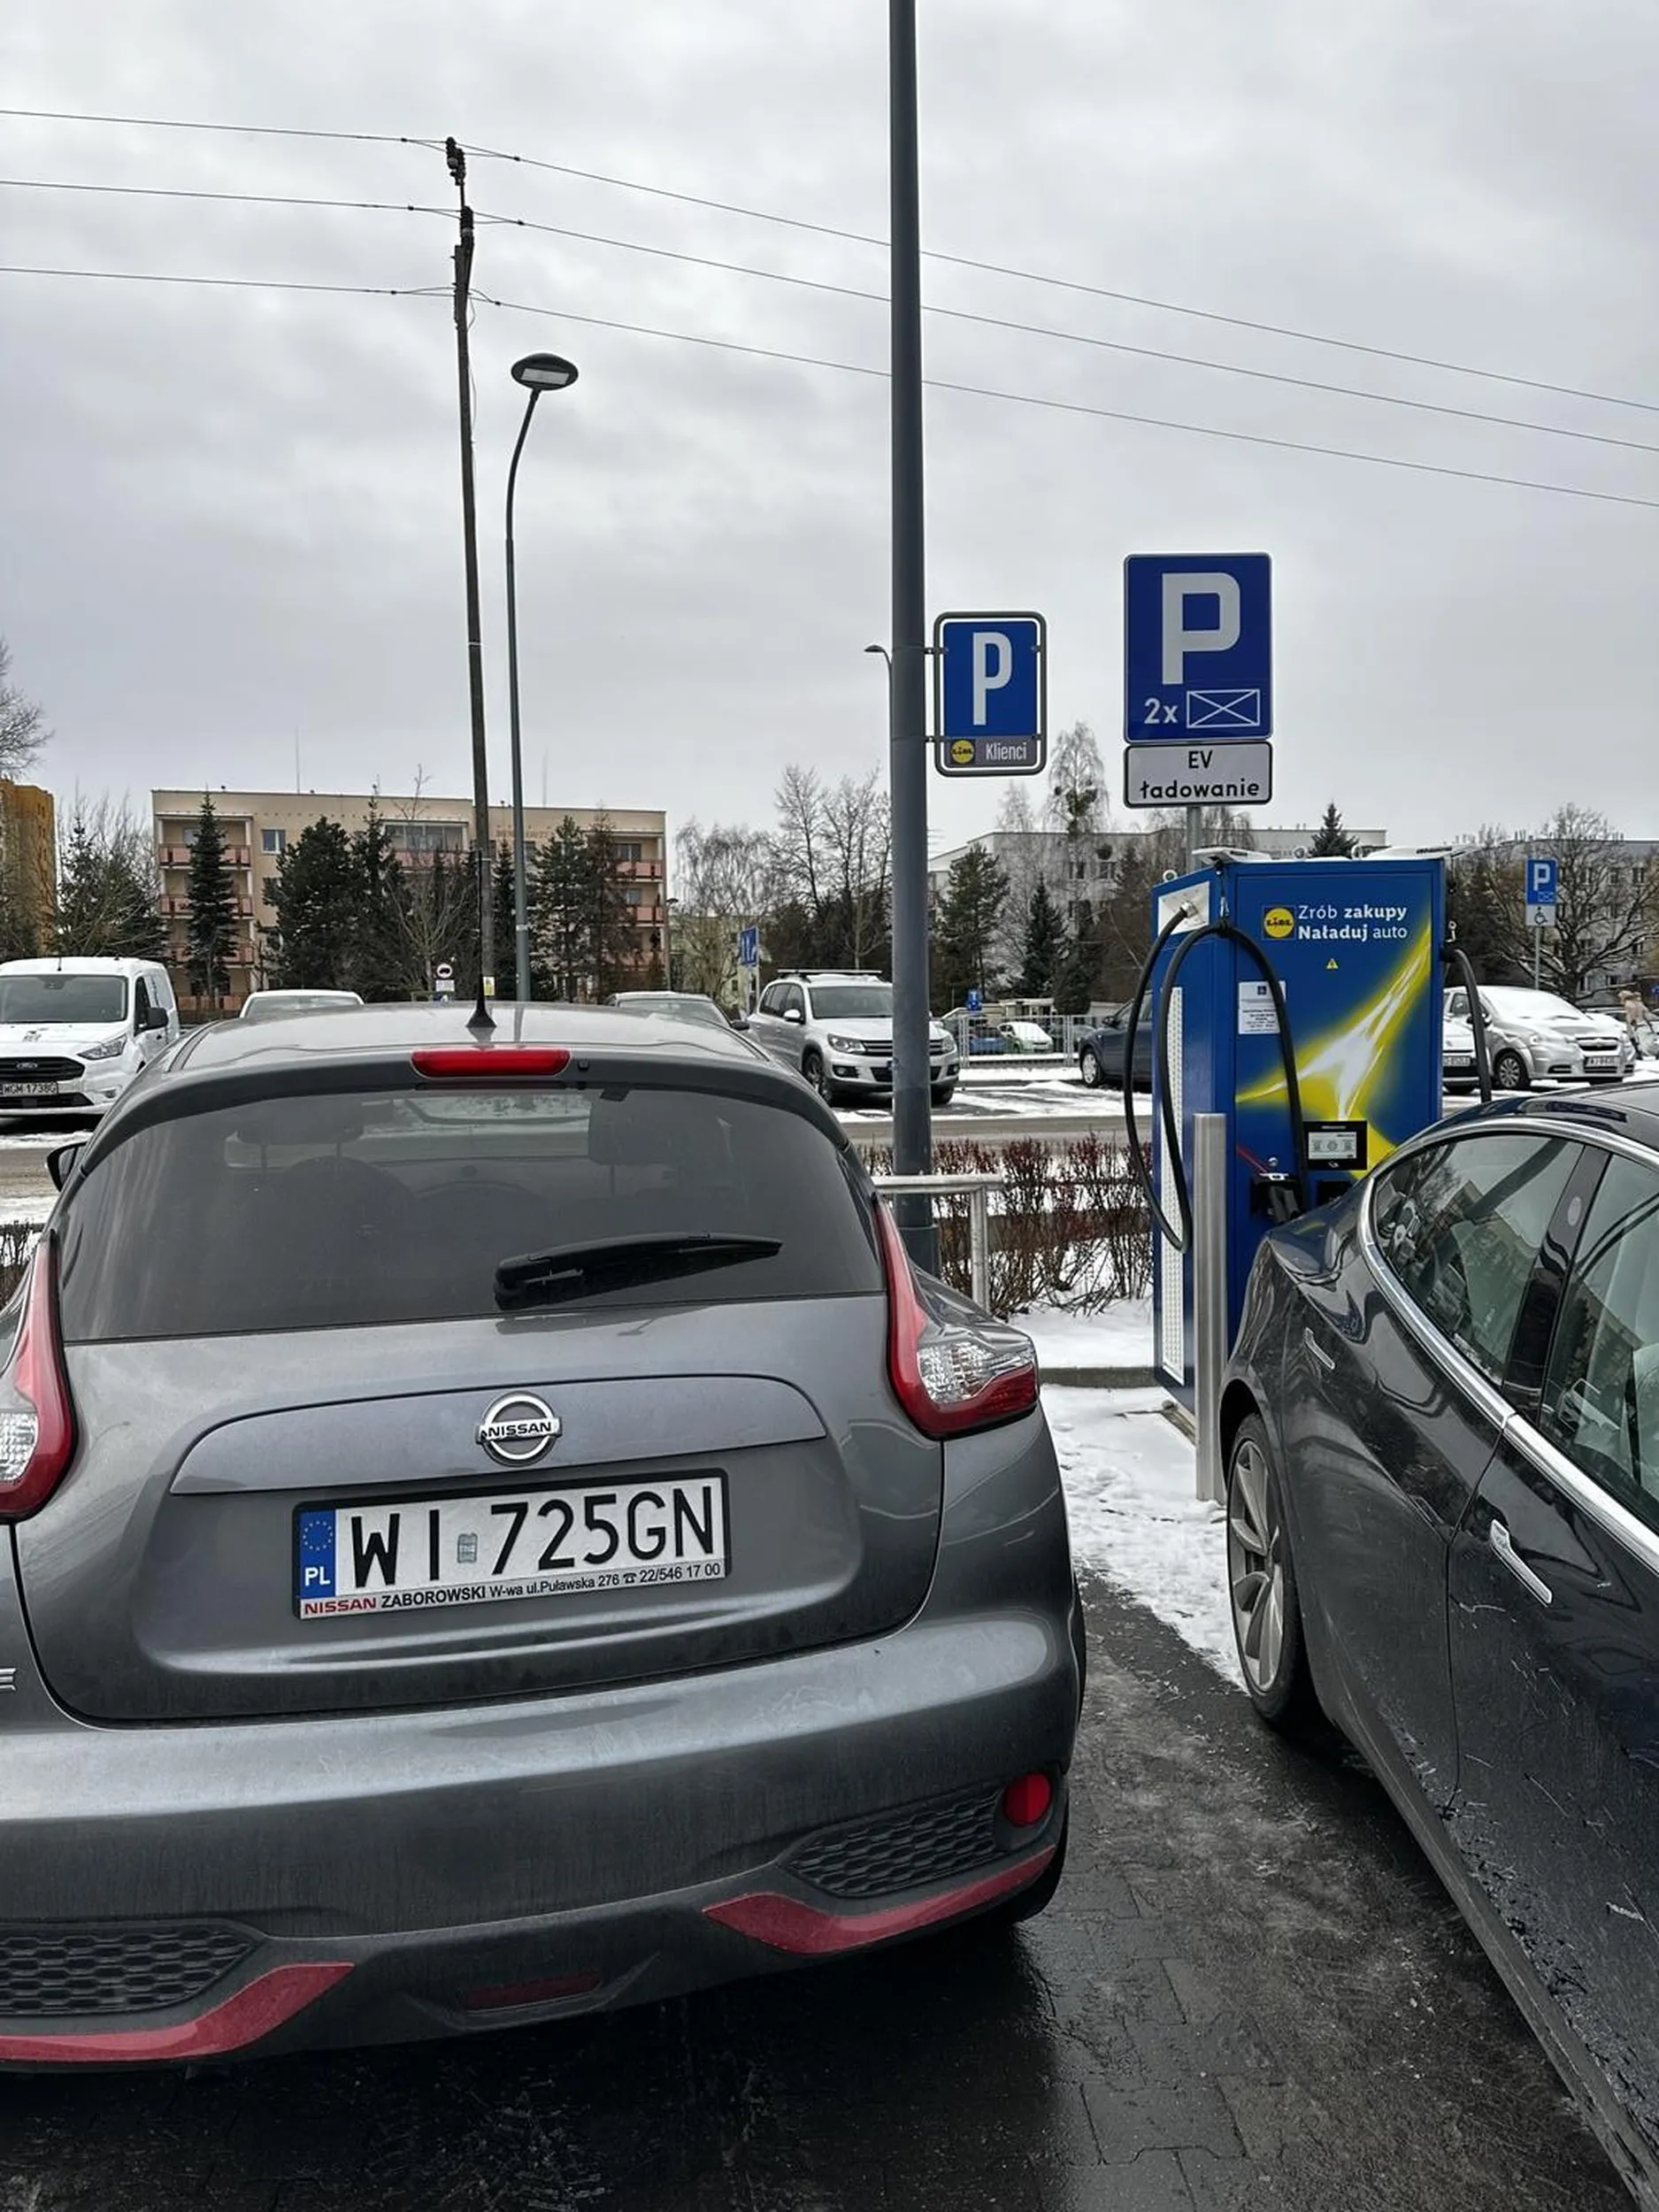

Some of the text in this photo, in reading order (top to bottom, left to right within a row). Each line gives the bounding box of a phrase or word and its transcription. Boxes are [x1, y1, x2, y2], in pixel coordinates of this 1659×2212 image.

[1162, 572, 1240, 685] P
[972, 632, 1013, 726] P
[1144, 697, 1179, 724] 2x
[985, 742, 1027, 760] Klienci
[1188, 750, 1213, 769] EV
[1141, 778, 1260, 799] ładowanie
[1533, 864, 1550, 891] P
[1298, 904, 1407, 921] Zrób zakupy
[1298, 924, 1408, 941] Naładuj auto
[488, 1422, 551, 1437] NISSAN
[351, 1486, 713, 1587] WI 725GN
[304, 1567, 331, 1586] PL
[304, 1597, 377, 1615] NISSAN
[381, 1586, 486, 1608] ZABOROWSKI
[489, 1583, 524, 1598] W-wa
[598, 1575, 620, 1587] 276
[639, 1566, 683, 1584] 22/546
[687, 1565, 702, 1578] 17
[705, 1563, 722, 1576] 00
